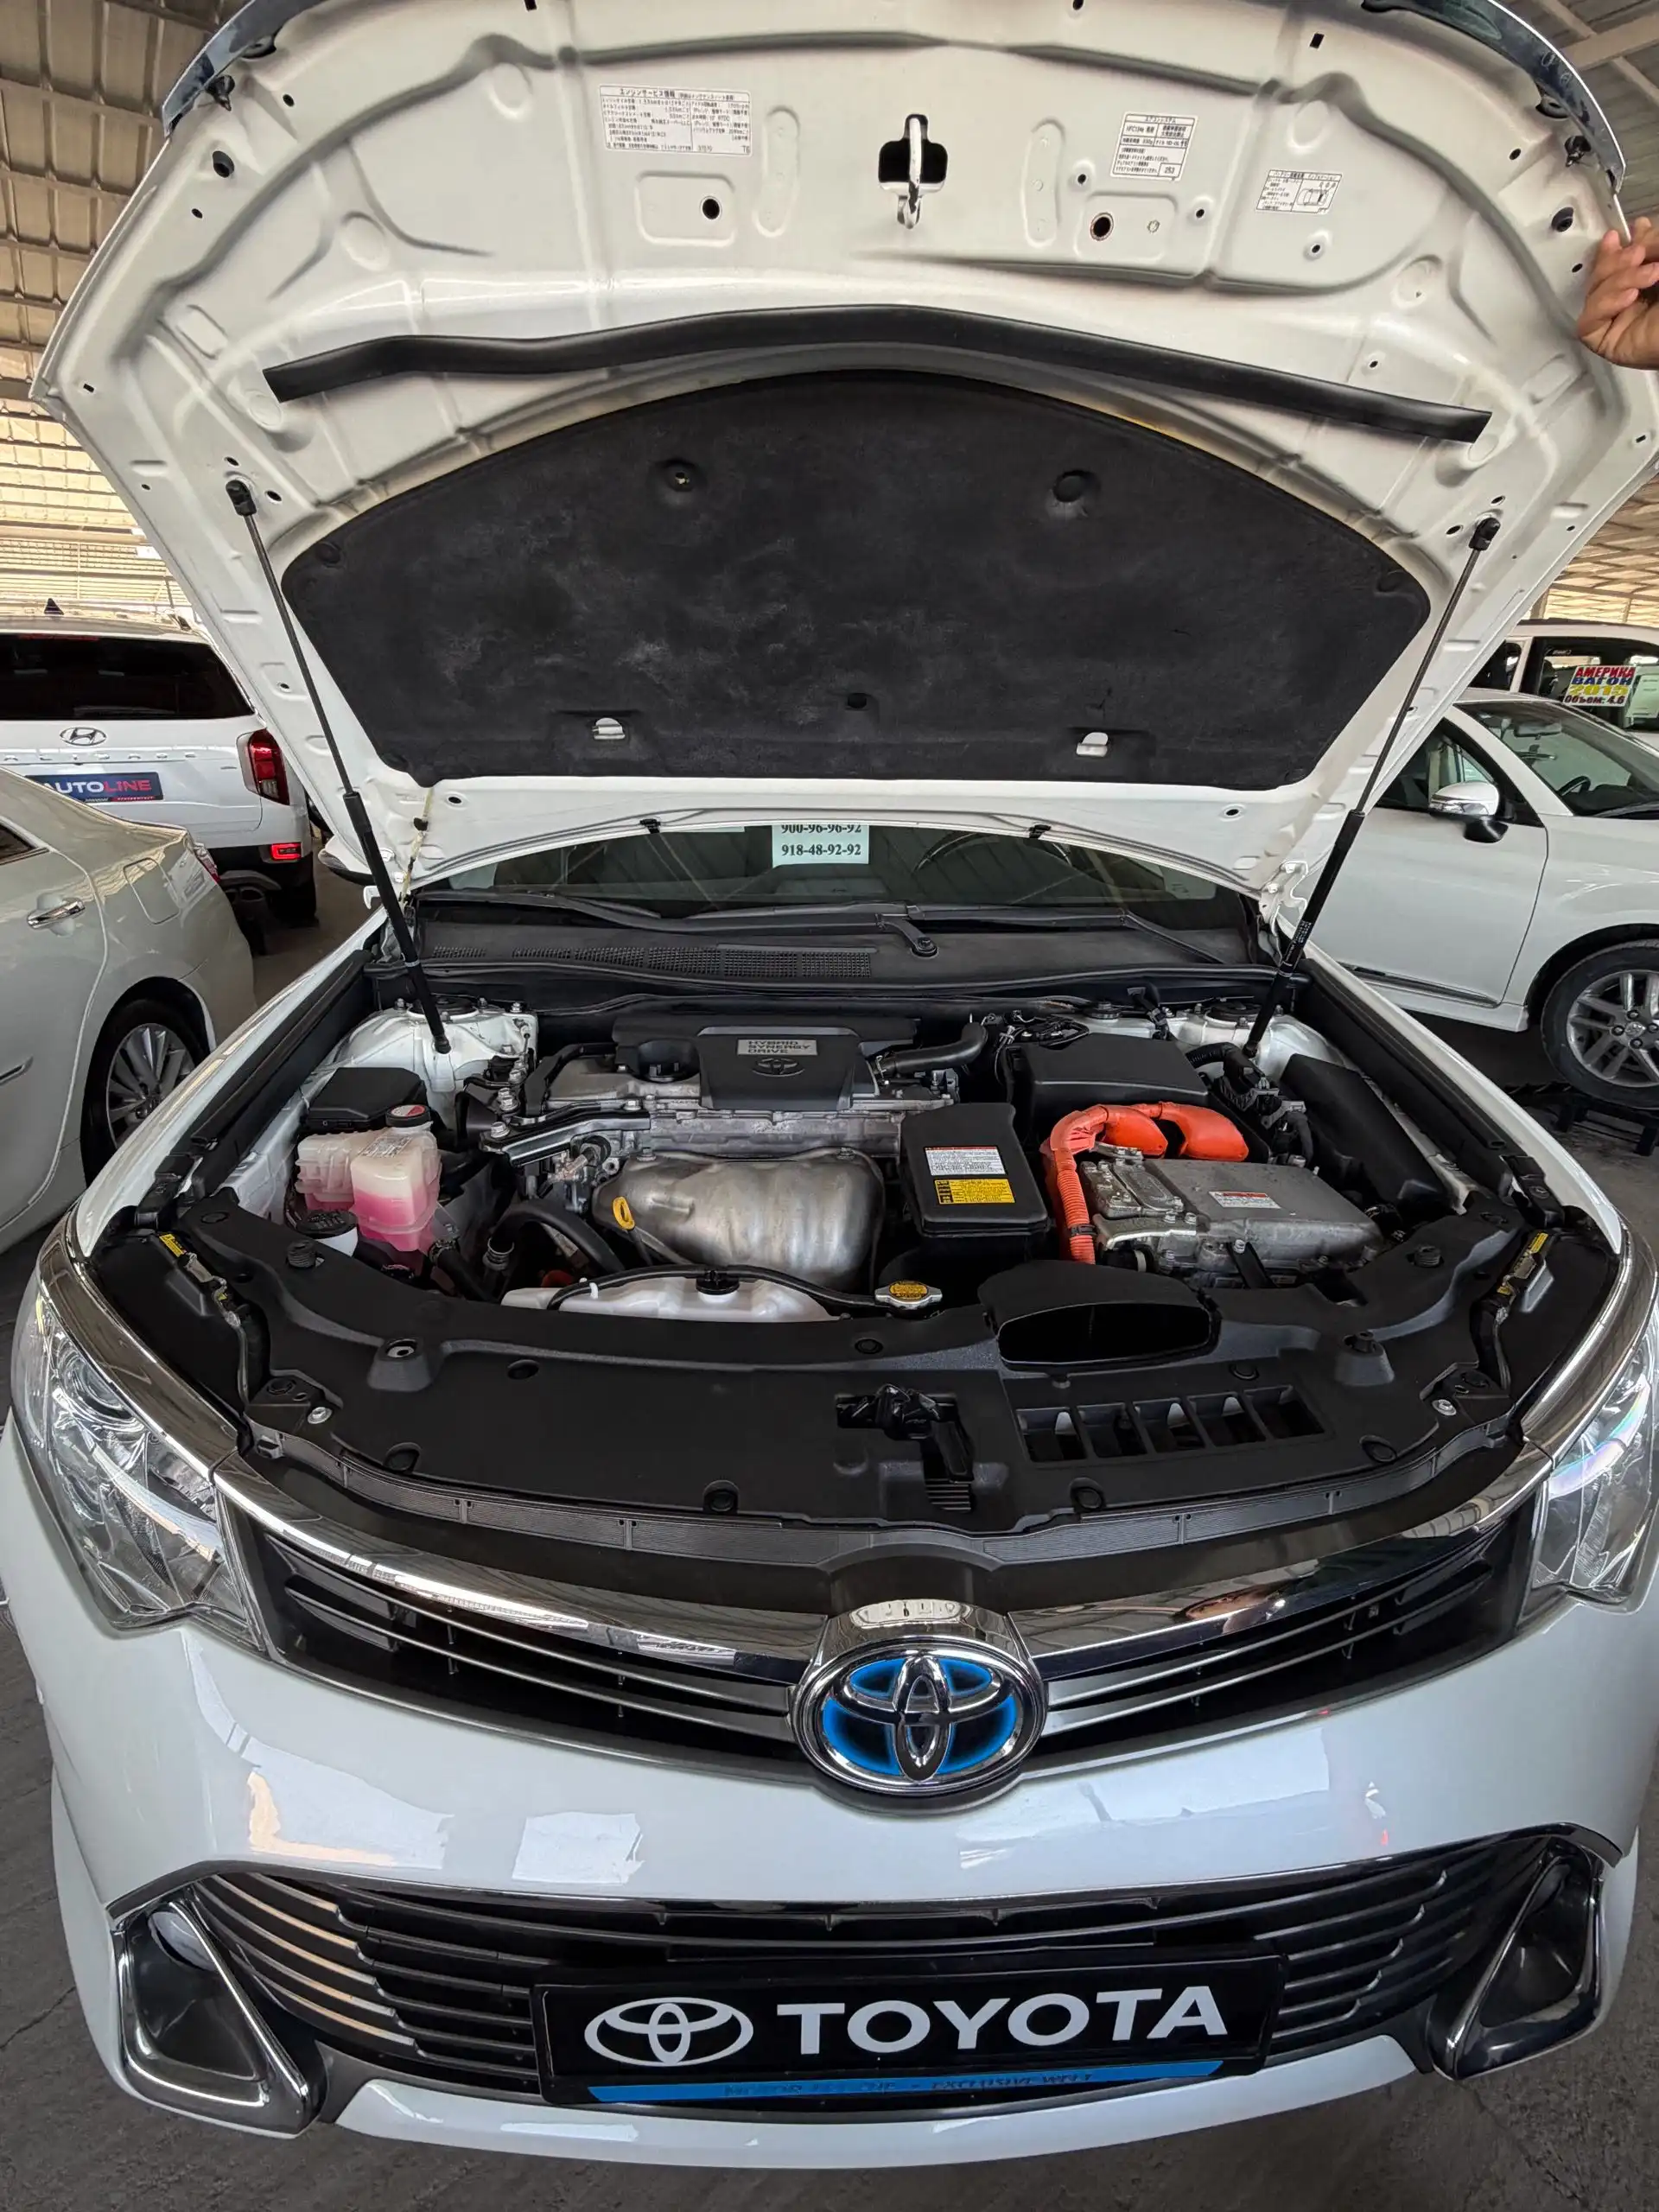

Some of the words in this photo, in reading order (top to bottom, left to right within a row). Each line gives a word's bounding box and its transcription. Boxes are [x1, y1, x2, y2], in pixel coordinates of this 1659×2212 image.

[1568, 684, 1628, 696] 2015
[781, 843, 861, 856] 918-48-92-92
[777, 1986, 1228, 2055] TOYOTA
